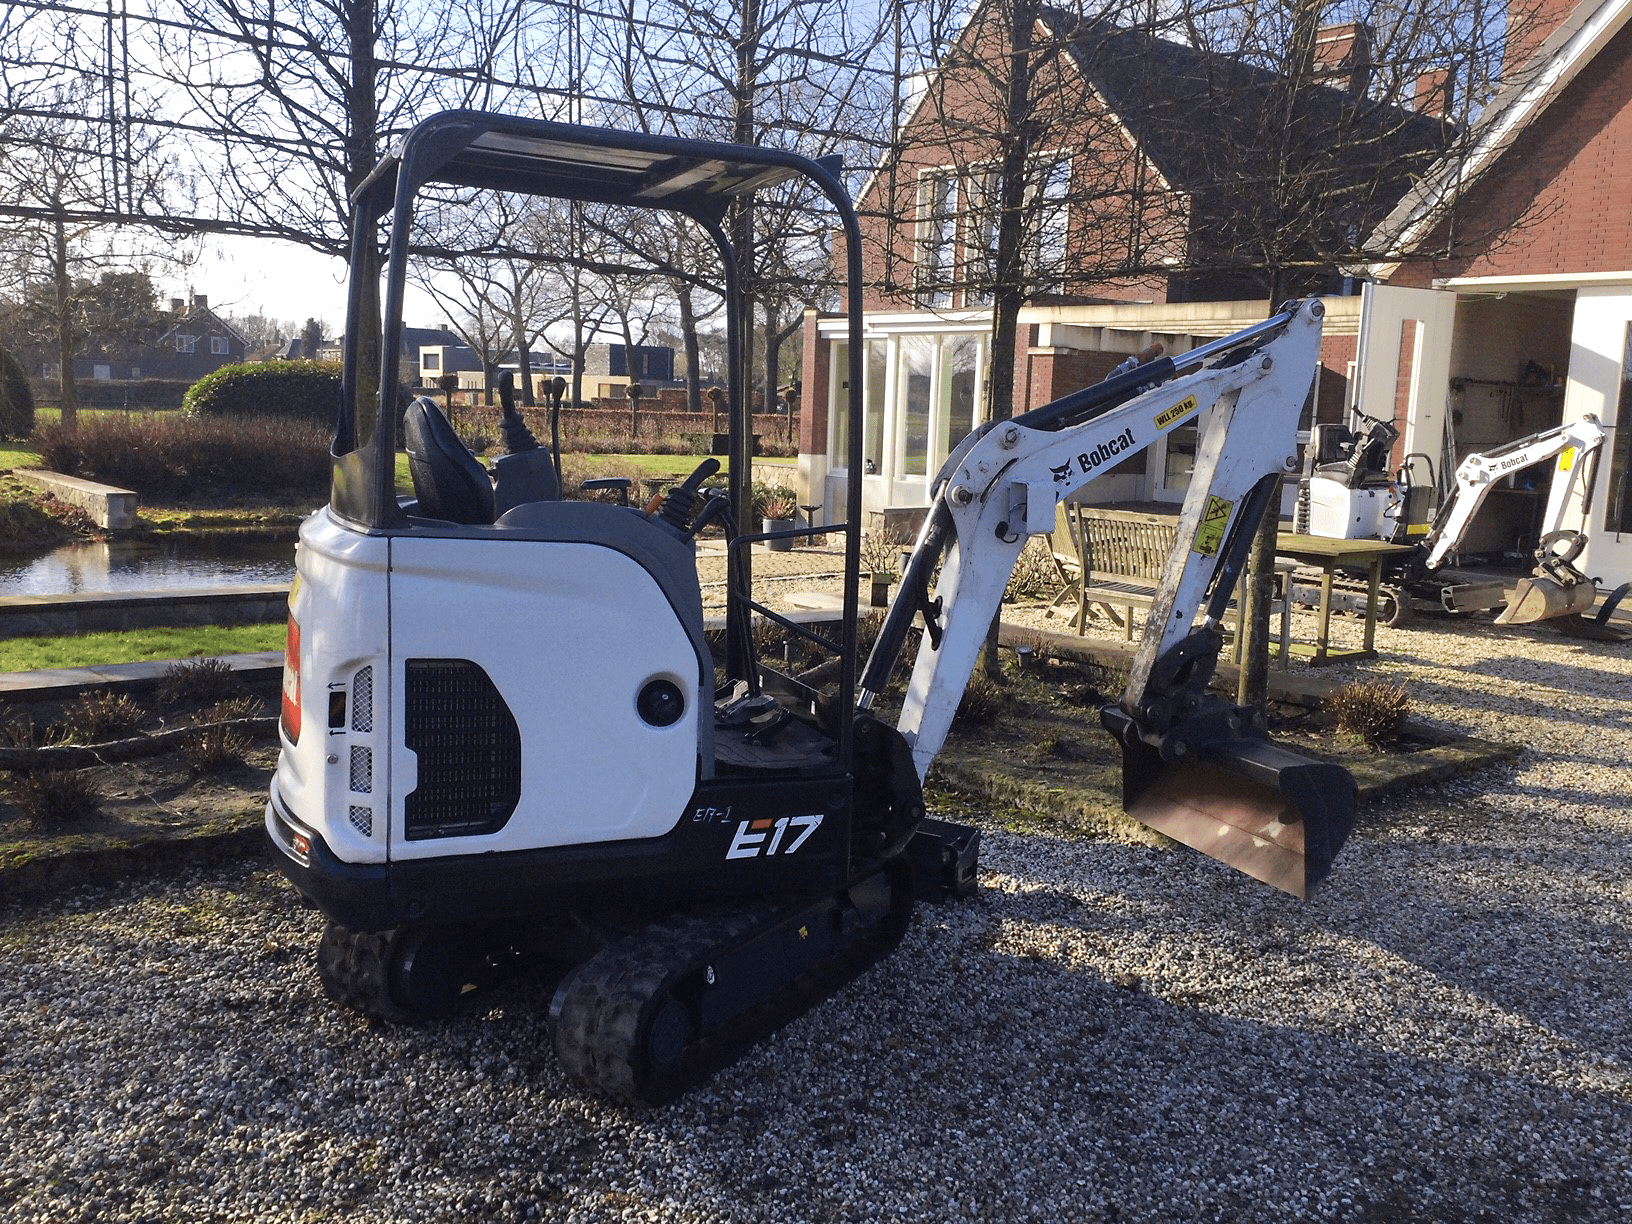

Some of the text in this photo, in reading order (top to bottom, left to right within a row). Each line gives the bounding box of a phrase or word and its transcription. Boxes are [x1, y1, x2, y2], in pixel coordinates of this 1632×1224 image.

[1156, 412, 1172, 426] WLL
[1170, 404, 1184, 418] 250
[1077, 427, 1136, 473] Bobcat
[1500, 453, 1529, 470] Bobcat
[725, 814, 825, 860] E17
